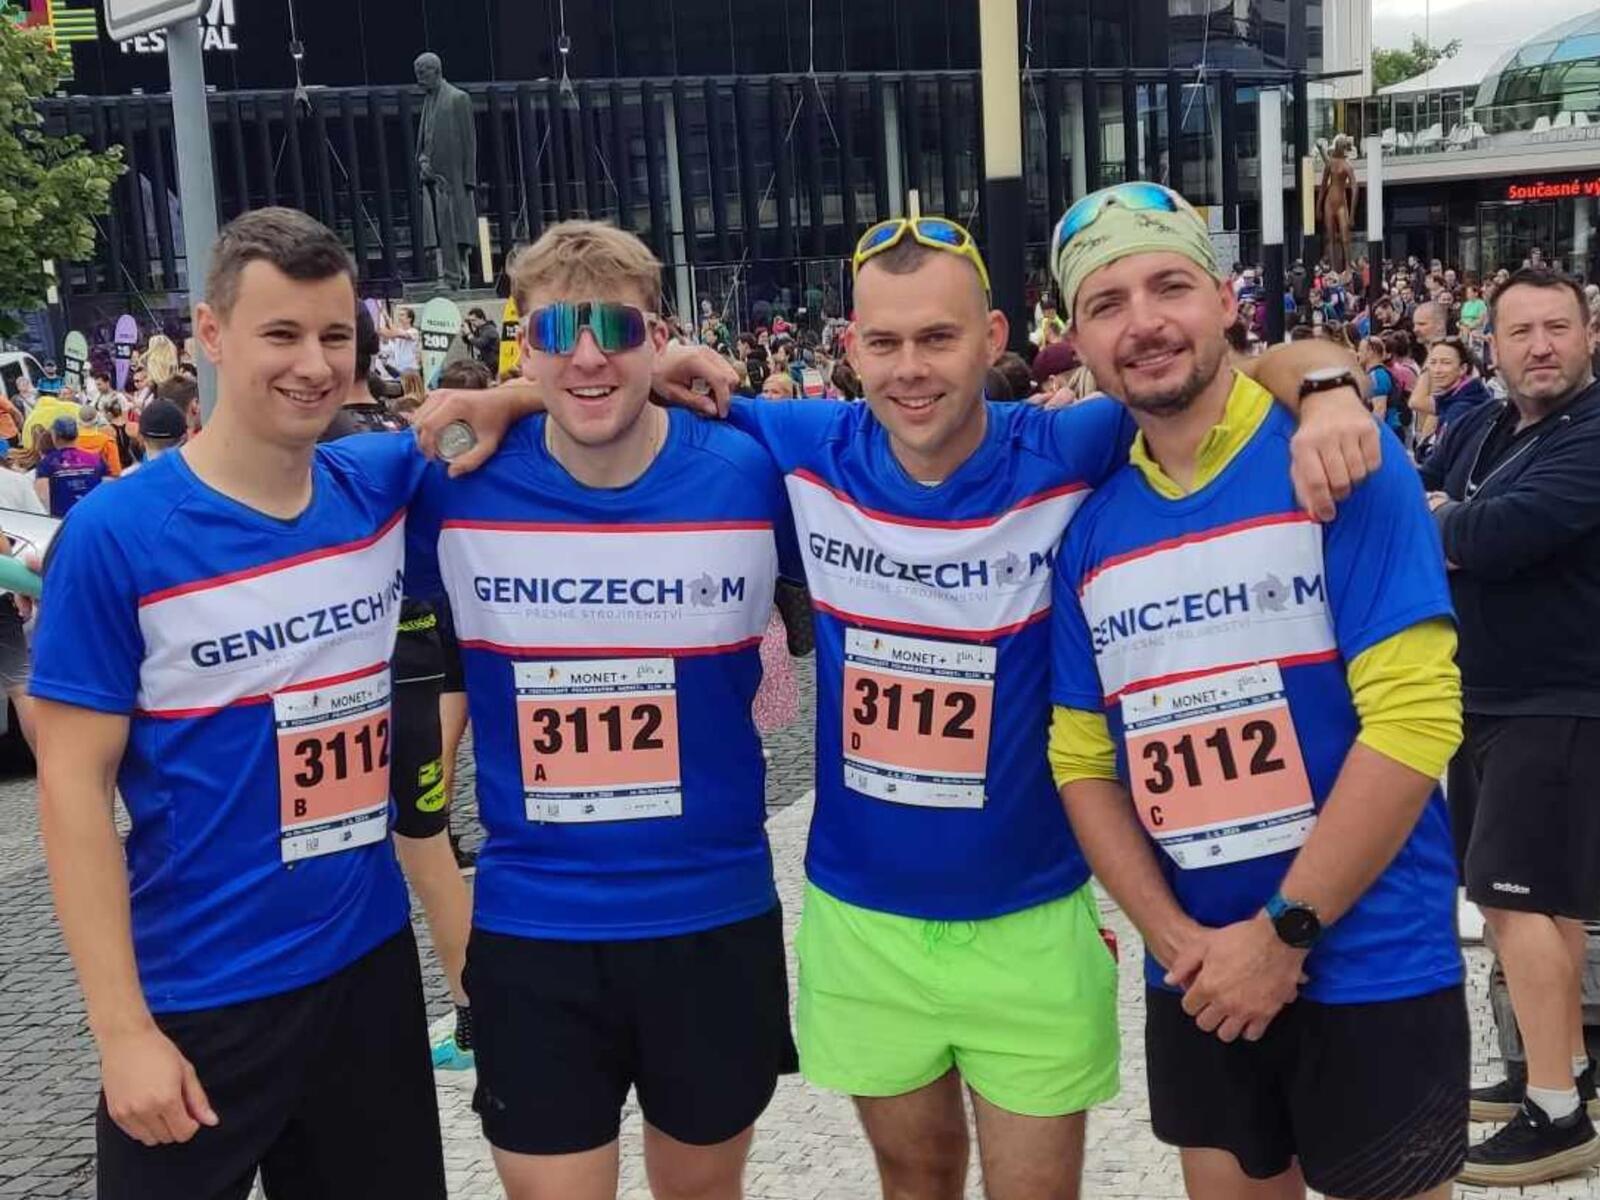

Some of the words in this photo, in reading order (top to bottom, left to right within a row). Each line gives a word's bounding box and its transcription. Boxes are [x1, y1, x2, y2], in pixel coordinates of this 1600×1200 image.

[120, 26, 238, 53] FESAL
[1508, 179, 1581, 199] Současné
[809, 532, 989, 589] GENICZECH
[473, 576, 684, 605] GENICZECH
[190, 592, 384, 668] GENICZECH
[853, 677, 977, 740] 3112
[532, 703, 664, 755] 3112
[851, 732, 861, 750] D
[294, 717, 389, 788] 3112
[1142, 719, 1286, 795] 3112
[534, 763, 547, 781] A
[294, 798, 307, 818] B
[1150, 805, 1164, 826] C
